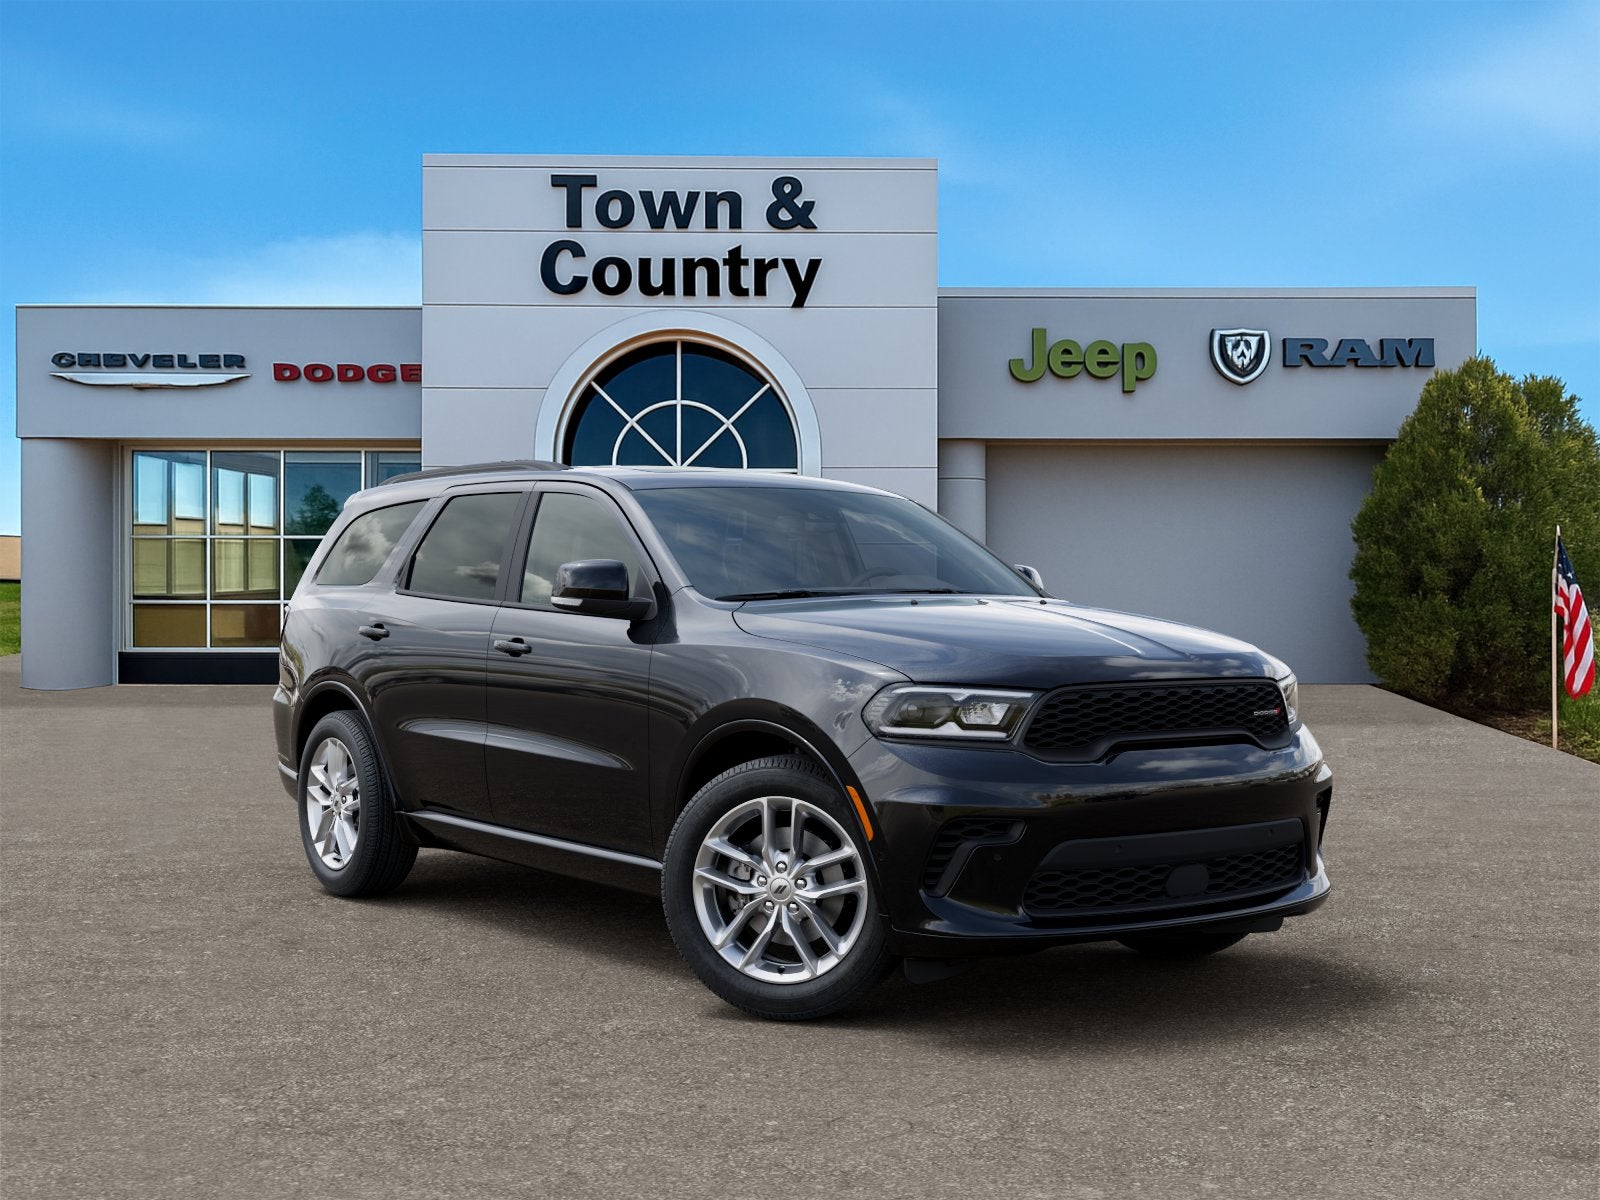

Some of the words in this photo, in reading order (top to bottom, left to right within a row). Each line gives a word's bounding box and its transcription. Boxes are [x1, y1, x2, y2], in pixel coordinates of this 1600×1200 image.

[551, 174, 742, 229] Town
[765, 176, 818, 229] &
[540, 239, 822, 307] Country
[273, 363, 422, 383] DODGE
[1009, 327, 1158, 393] Jeep
[1283, 337, 1435, 367] RAM
